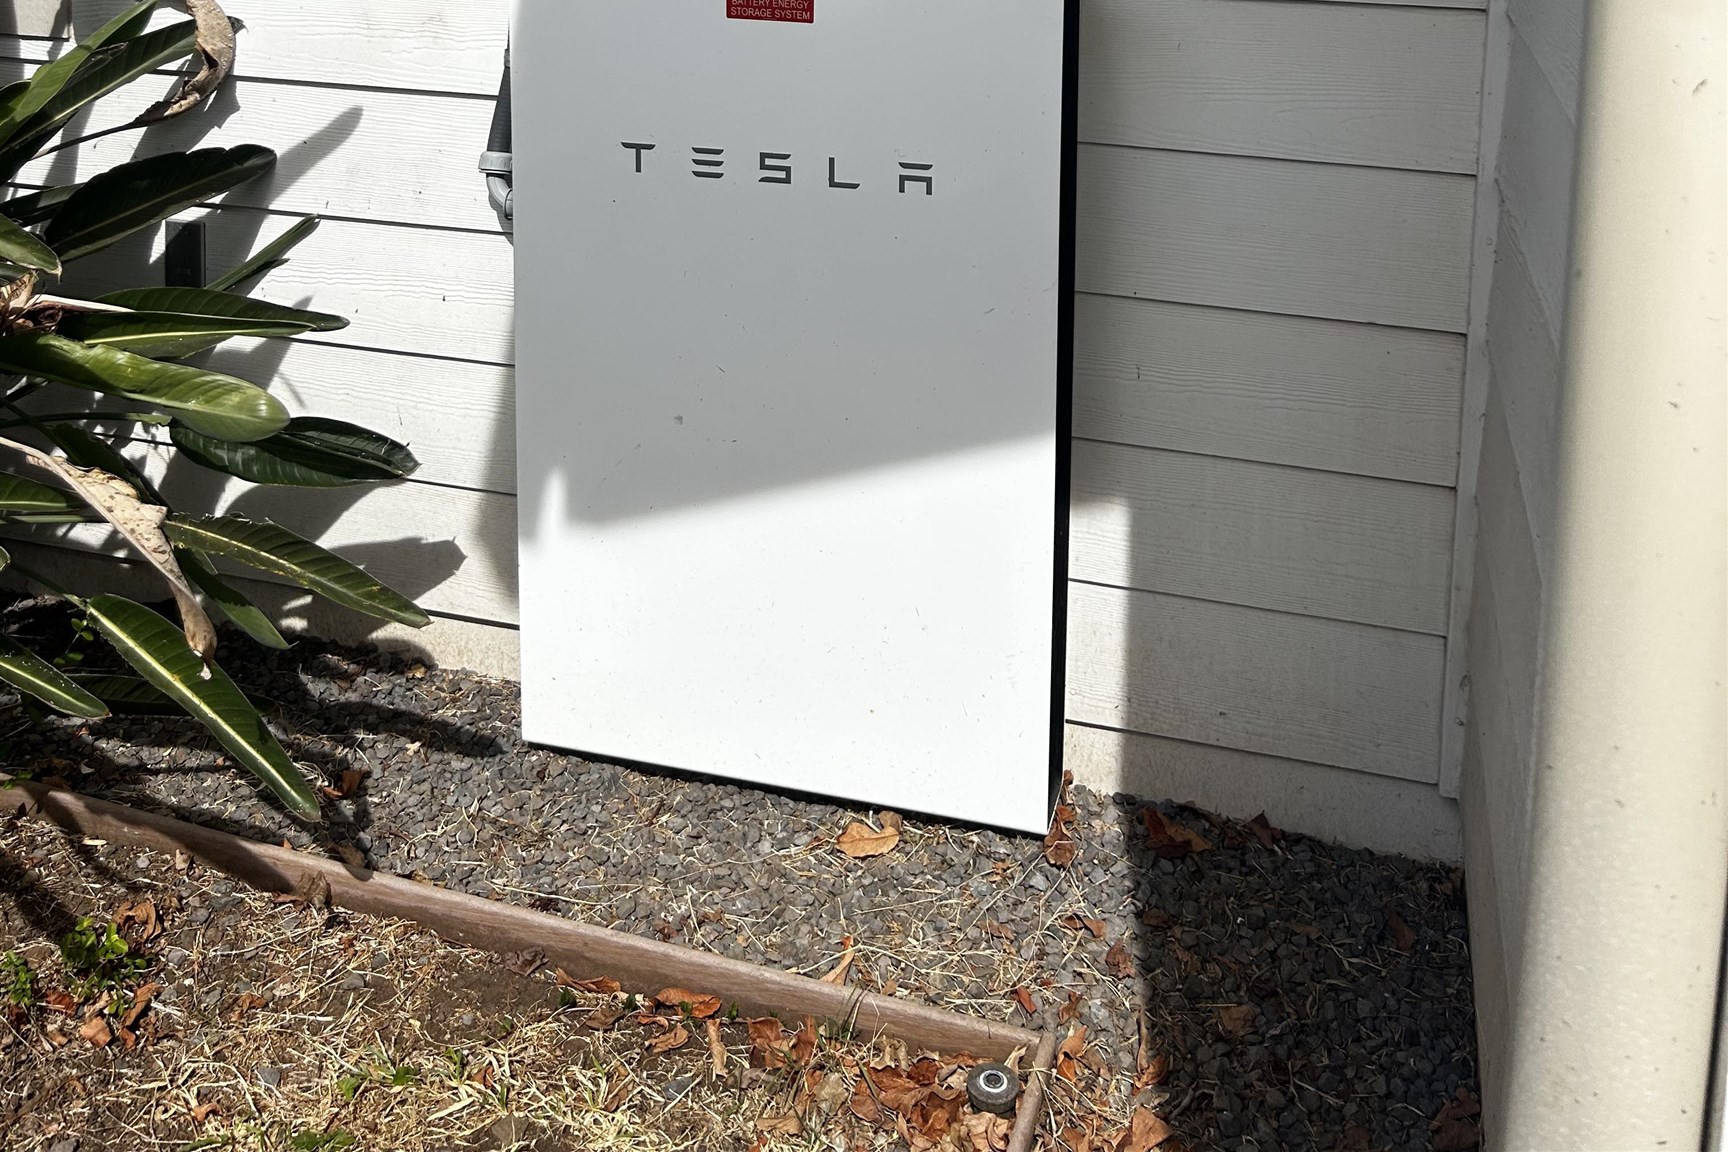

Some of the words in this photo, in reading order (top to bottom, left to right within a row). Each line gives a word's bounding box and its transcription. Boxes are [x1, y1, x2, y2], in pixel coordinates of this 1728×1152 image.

[730, 6, 773, 17] STORAGE
[774, 9, 810, 20] SYSTEM
[620, 141, 934, 196] TESLA
